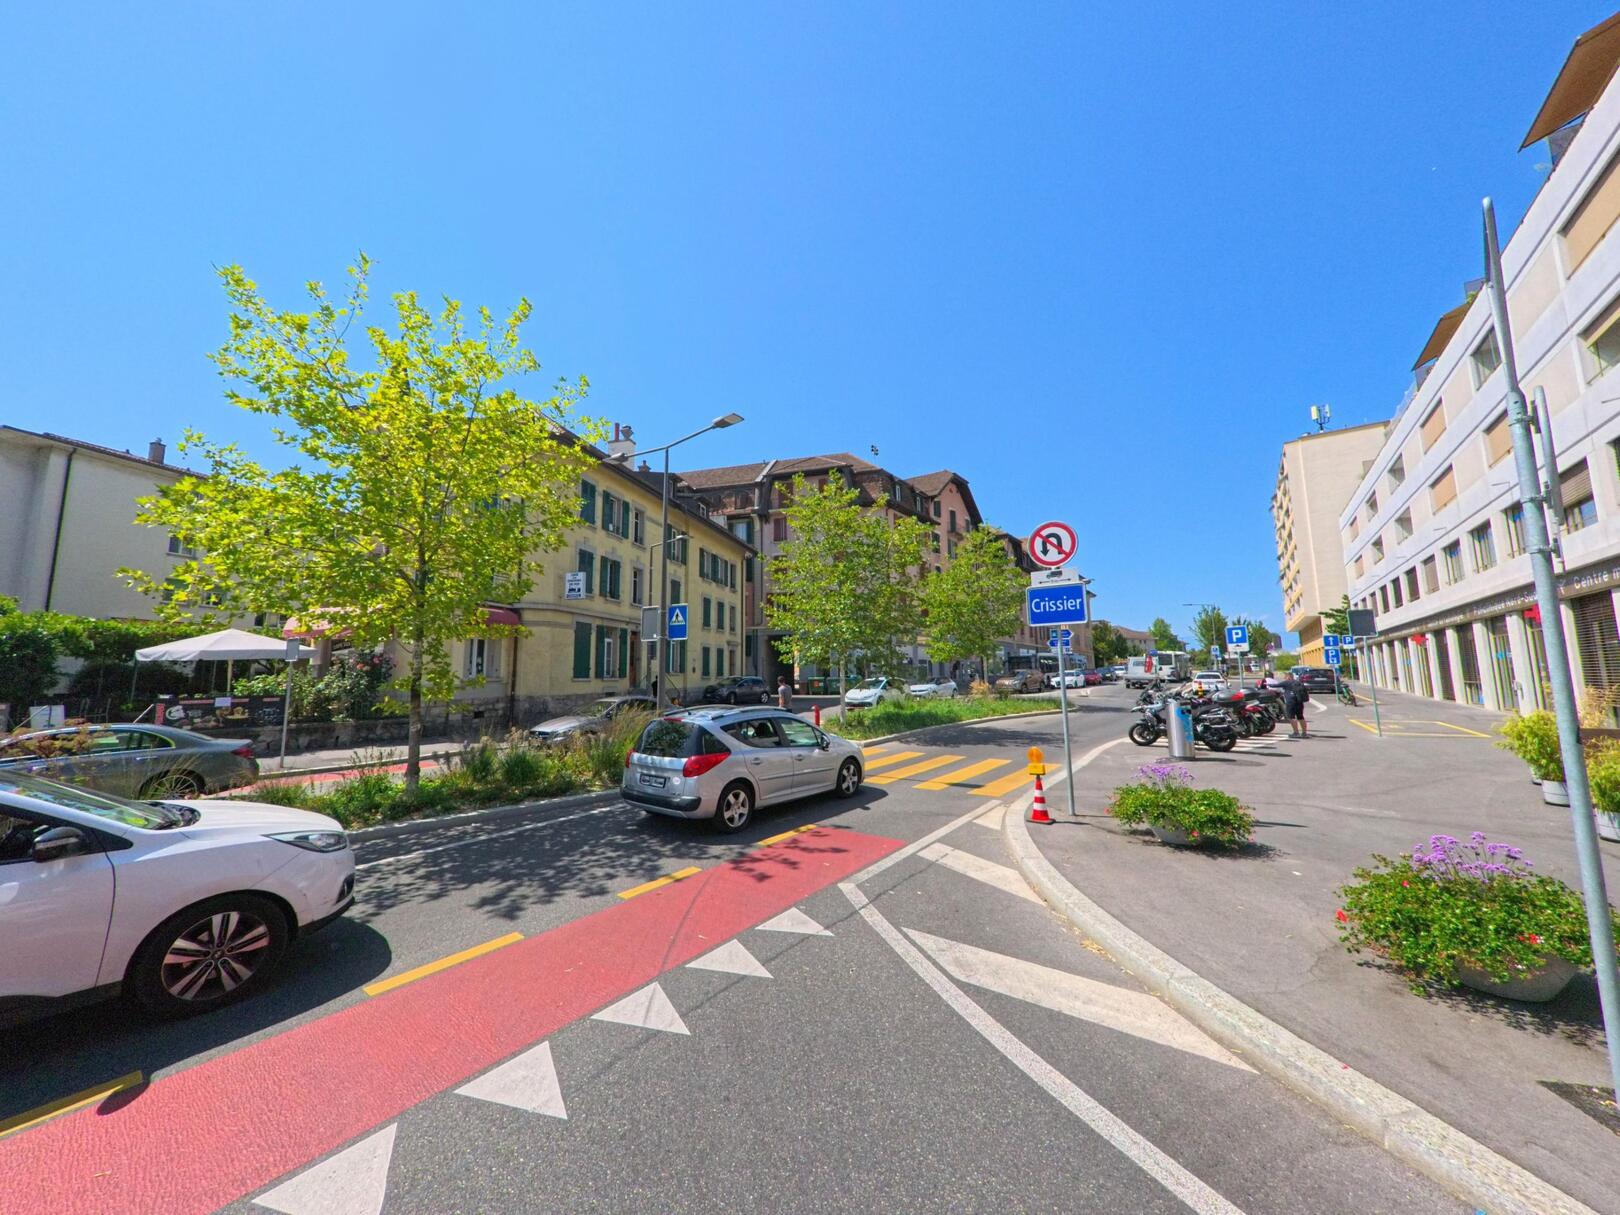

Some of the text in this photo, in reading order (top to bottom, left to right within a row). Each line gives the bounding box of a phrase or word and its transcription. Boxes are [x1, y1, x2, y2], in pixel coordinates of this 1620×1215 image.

[1573, 571, 1609, 589] Centre
[1031, 595, 1082, 613] Crissier
[1231, 630, 1242, 642] P
[1345, 636, 1351, 644] P
[1328, 650, 1335, 658] P
